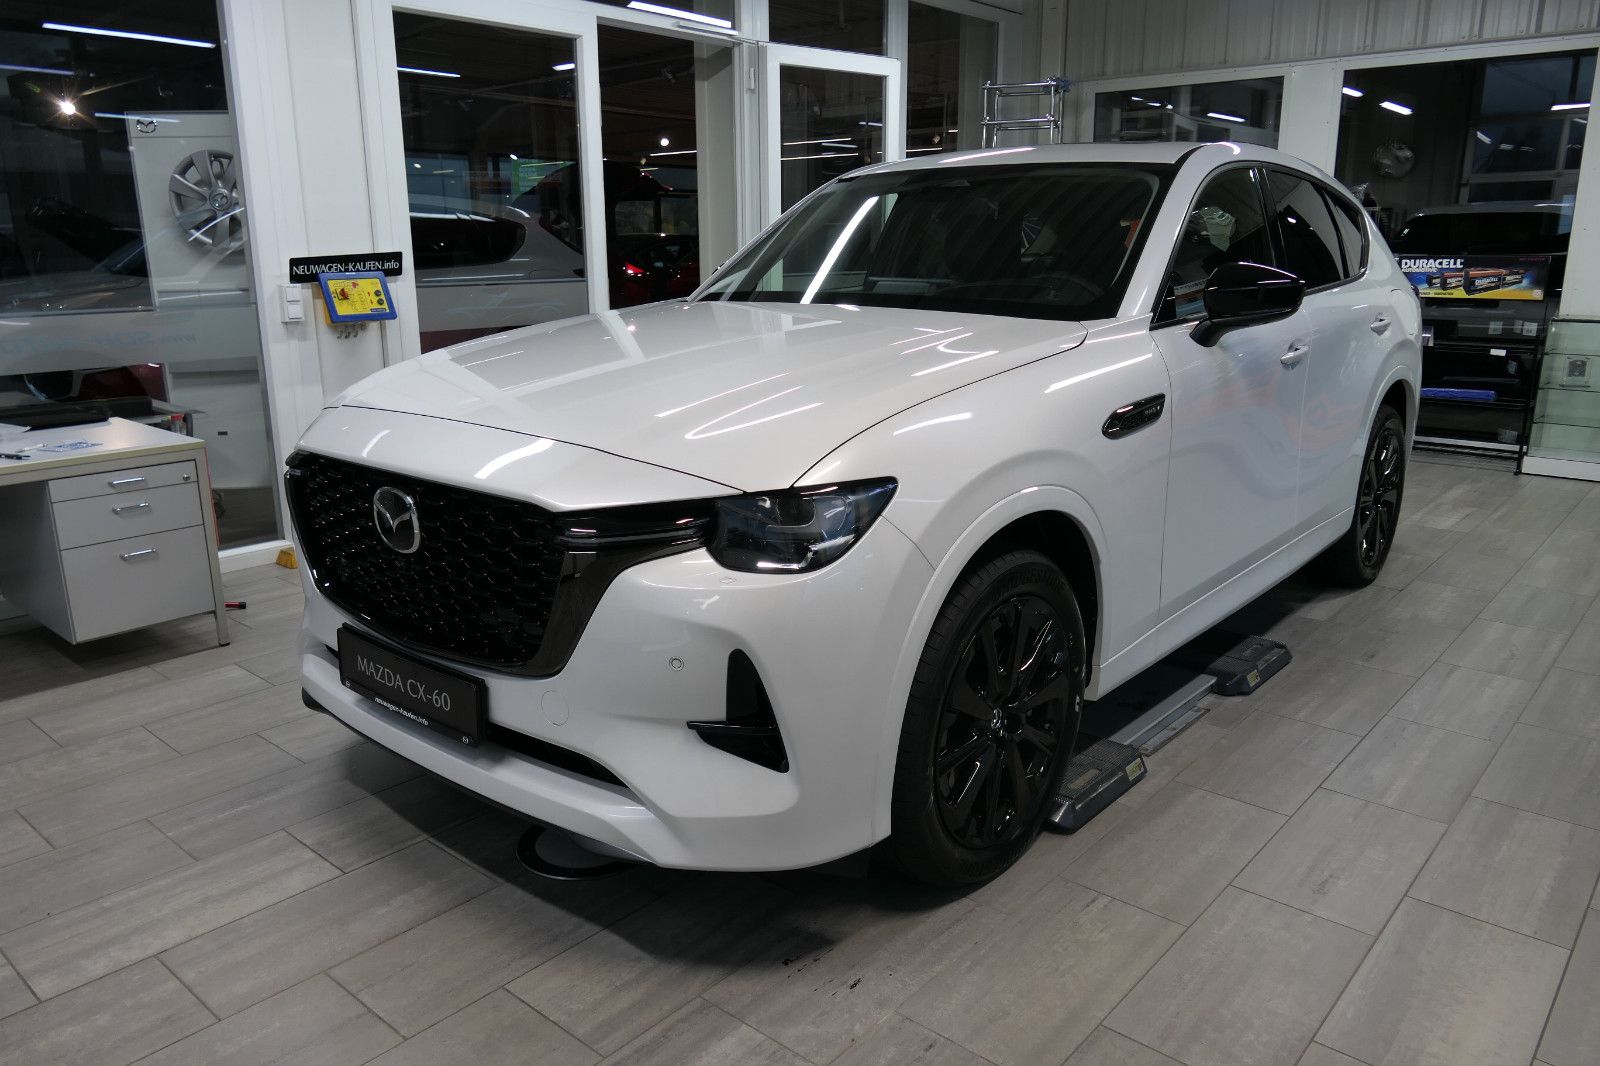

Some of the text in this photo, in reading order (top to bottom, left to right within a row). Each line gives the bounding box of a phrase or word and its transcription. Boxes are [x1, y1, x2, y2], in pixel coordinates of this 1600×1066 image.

[293, 259, 399, 275] NEUWAGEN-KAUFEN.info
[1401, 258, 1463, 268] DURACELL
[357, 654, 451, 711] MAZDA CX-60
[374, 697, 429, 726] neuwagen-kaufen.info
